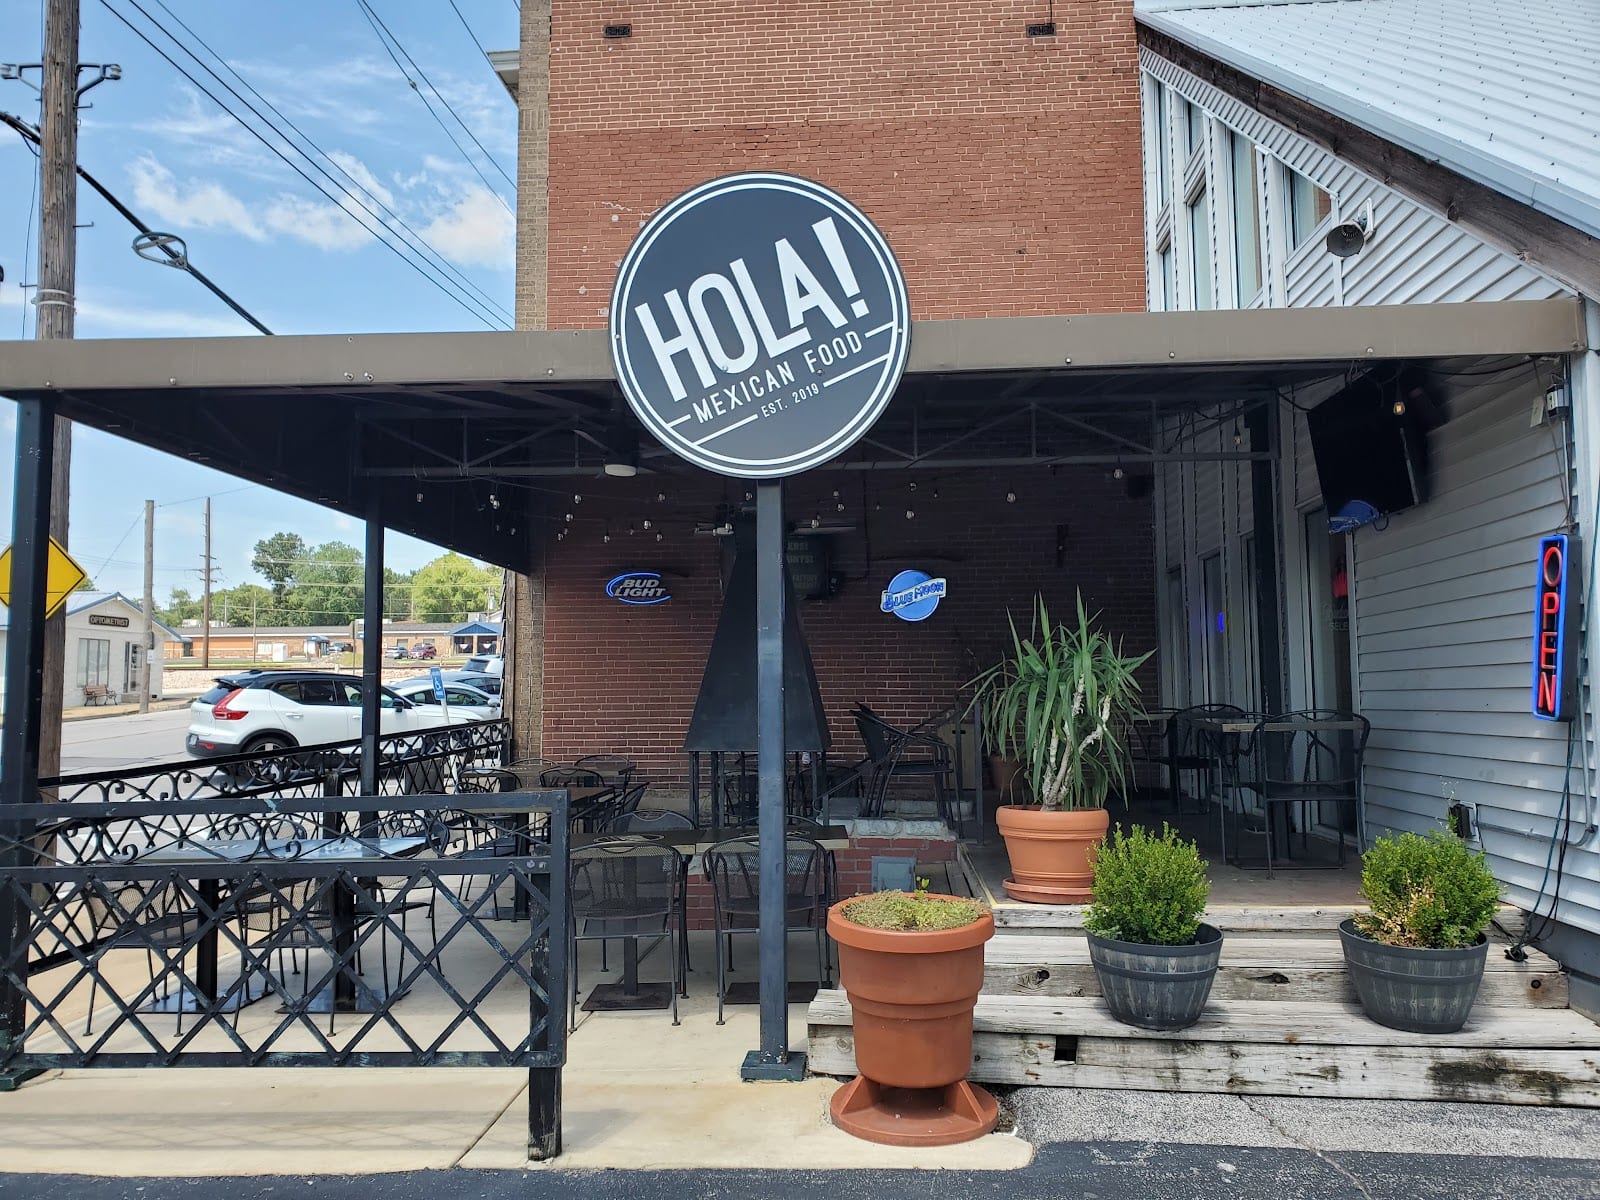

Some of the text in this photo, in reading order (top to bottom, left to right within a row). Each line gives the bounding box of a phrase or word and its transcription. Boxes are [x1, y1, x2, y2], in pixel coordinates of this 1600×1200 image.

[634, 217, 870, 402] HOLA!
[692, 330, 863, 424] MEXICAN FOOD
[761, 382, 820, 418] EST. 2019
[614, 587, 667, 597] LIGHT
[622, 579, 660, 588] BUD
[90, 615, 129, 627] OPTOMETRIST
[1538, 546, 1563, 713] OPEN
